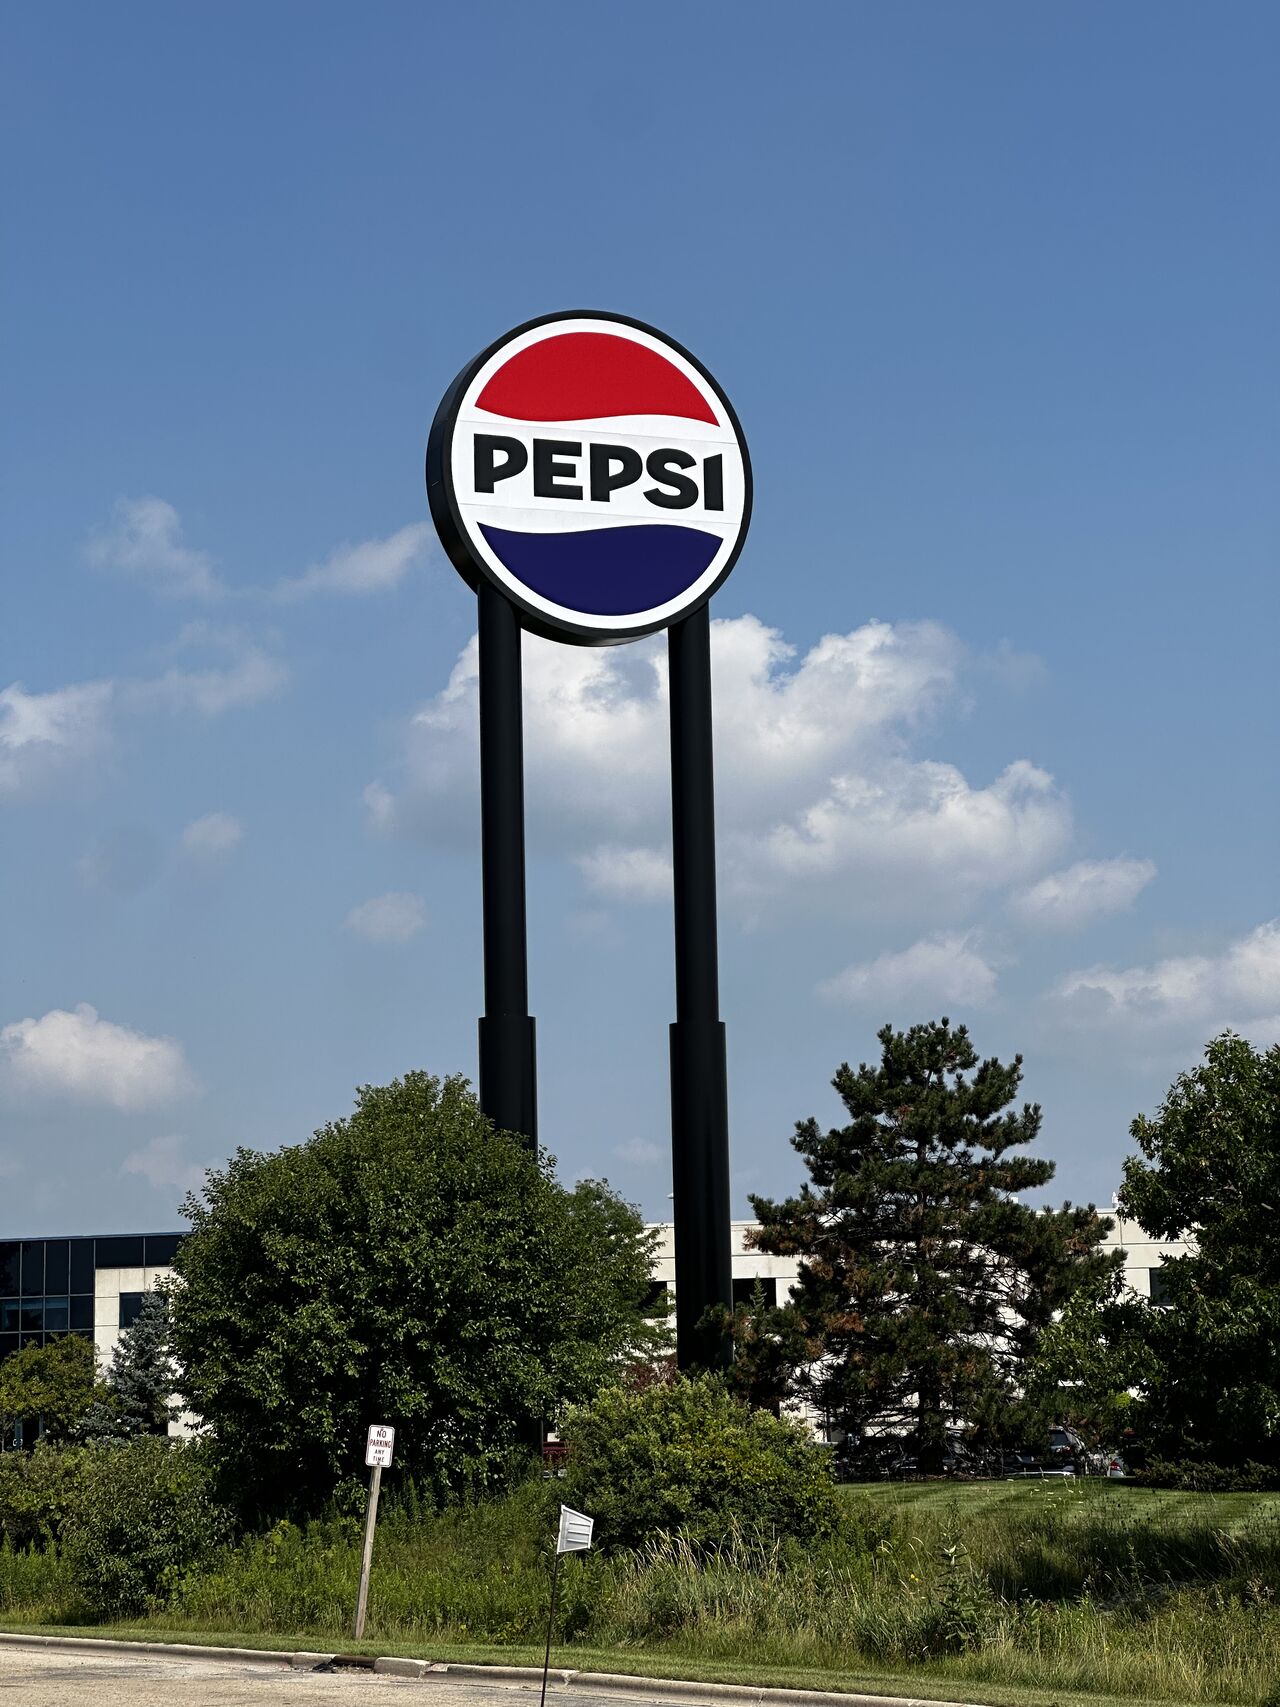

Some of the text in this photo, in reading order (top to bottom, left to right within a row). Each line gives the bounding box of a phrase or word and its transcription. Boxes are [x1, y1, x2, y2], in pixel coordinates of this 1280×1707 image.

[474, 433, 724, 511] PEPSI
[376, 1430, 387, 1438] NO
[370, 1439, 392, 1448] PARKING
